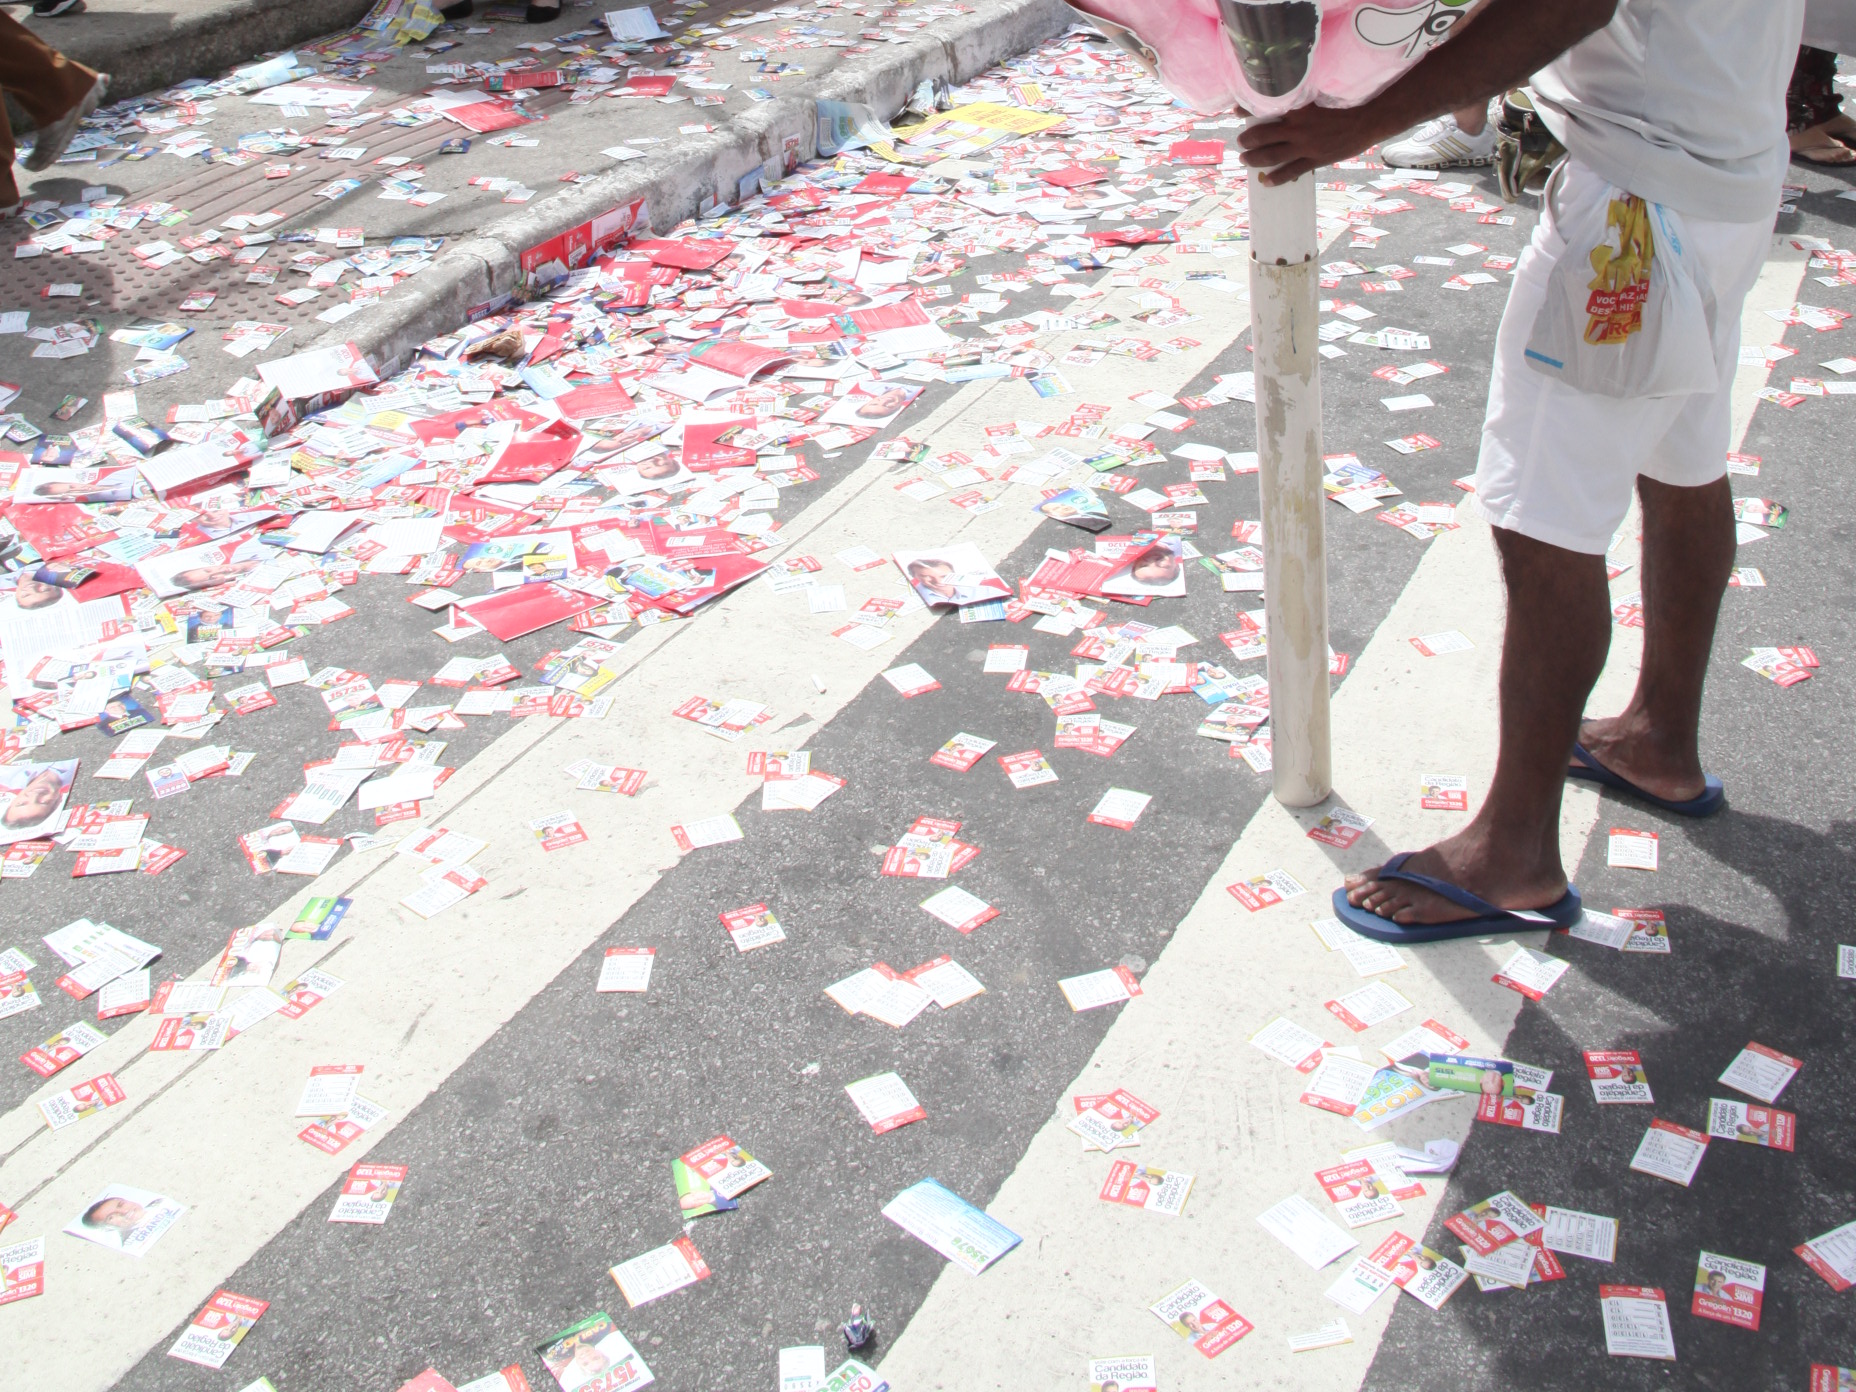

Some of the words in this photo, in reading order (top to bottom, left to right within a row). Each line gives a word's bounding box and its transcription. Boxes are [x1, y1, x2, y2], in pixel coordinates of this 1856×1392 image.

[1595, 295, 1617, 305] VOC
[1599, 1089, 1647, 1097] Candidato
[1716, 1103, 1728, 1135] Candidato
[1728, 1127, 1734, 1136] da
[1492, 1199, 1502, 1209] da
[1499, 1195, 1535, 1226] Candidato
[1704, 1255, 1759, 1276] Candidato
[1704, 1261, 1720, 1271] da
[1159, 1285, 1200, 1314] Candidato
[1698, 1297, 1732, 1314] Gregolin
[1733, 1308, 1753, 1320] 1320
[1166, 1309, 1179, 1320] da
[1202, 1328, 1227, 1349] Gregolin
[1225, 1319, 1244, 1333] 1320
[1094, 1361, 1149, 1373] Candidato
[1095, 1371, 1108, 1381] da
